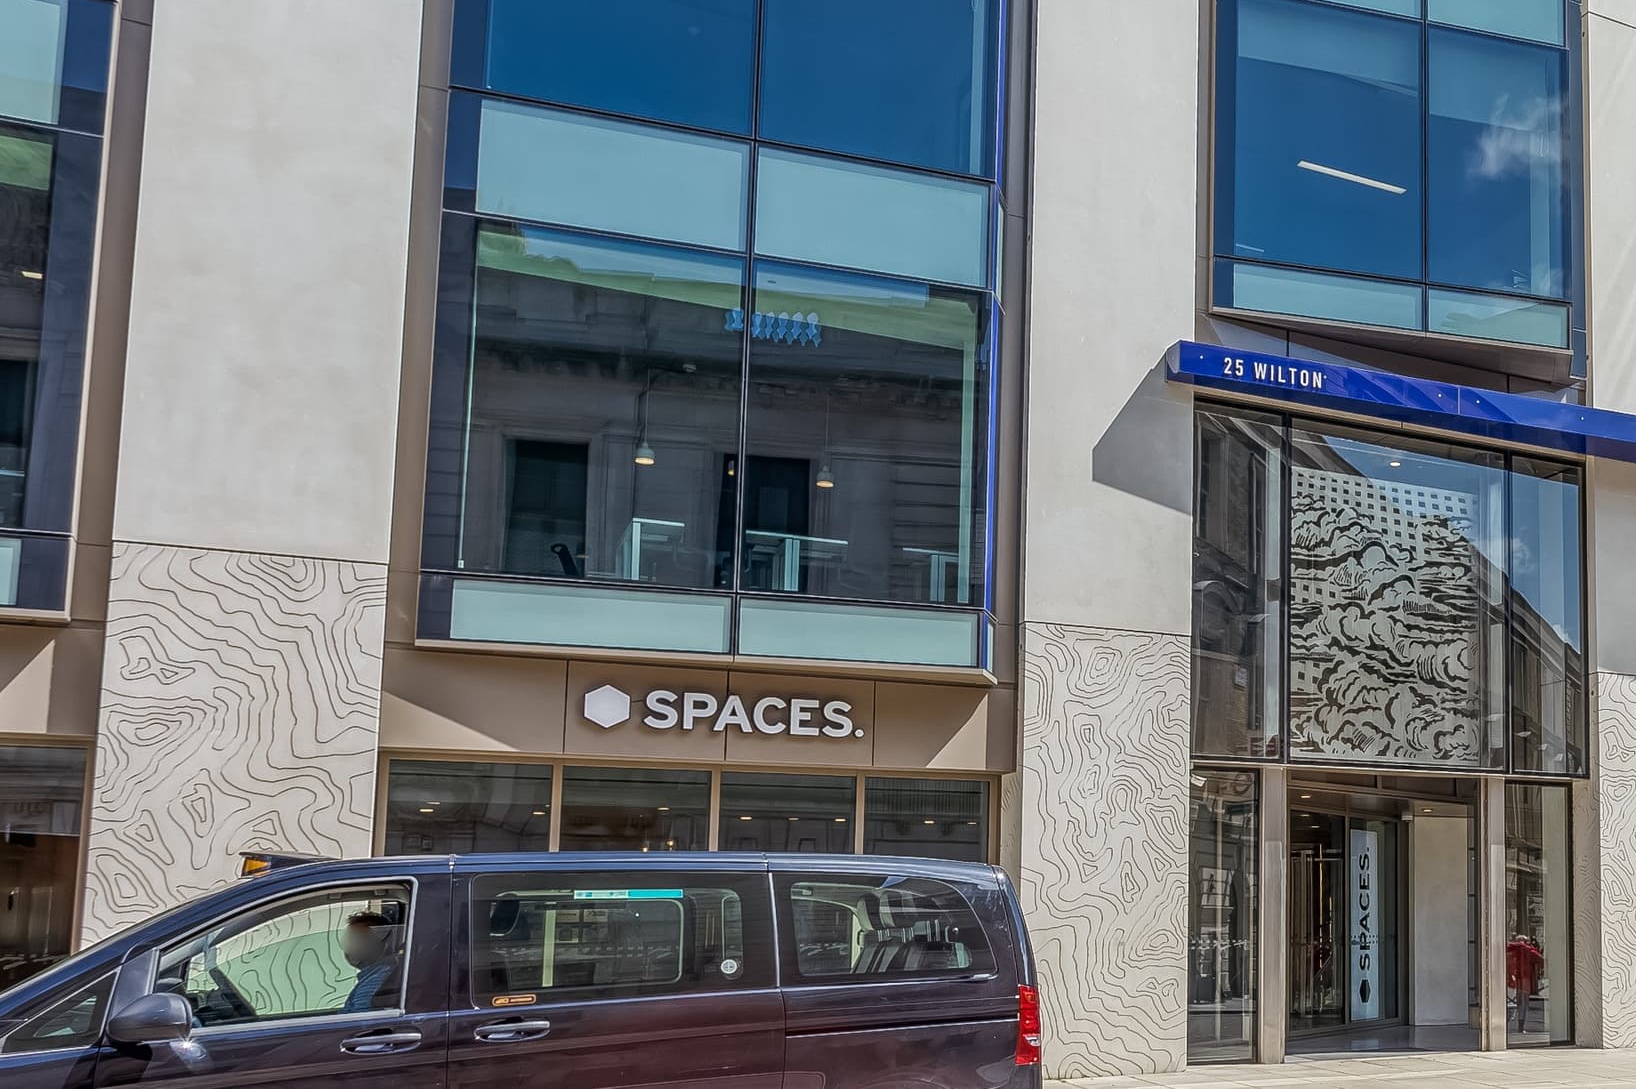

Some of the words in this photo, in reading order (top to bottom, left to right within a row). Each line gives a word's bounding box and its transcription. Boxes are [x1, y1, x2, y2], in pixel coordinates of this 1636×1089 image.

[1223, 357, 1244, 376] 25
[1253, 361, 1322, 388] WILTON
[643, 689, 864, 738] SPACES.
[1359, 846, 1371, 971] SPACES.
